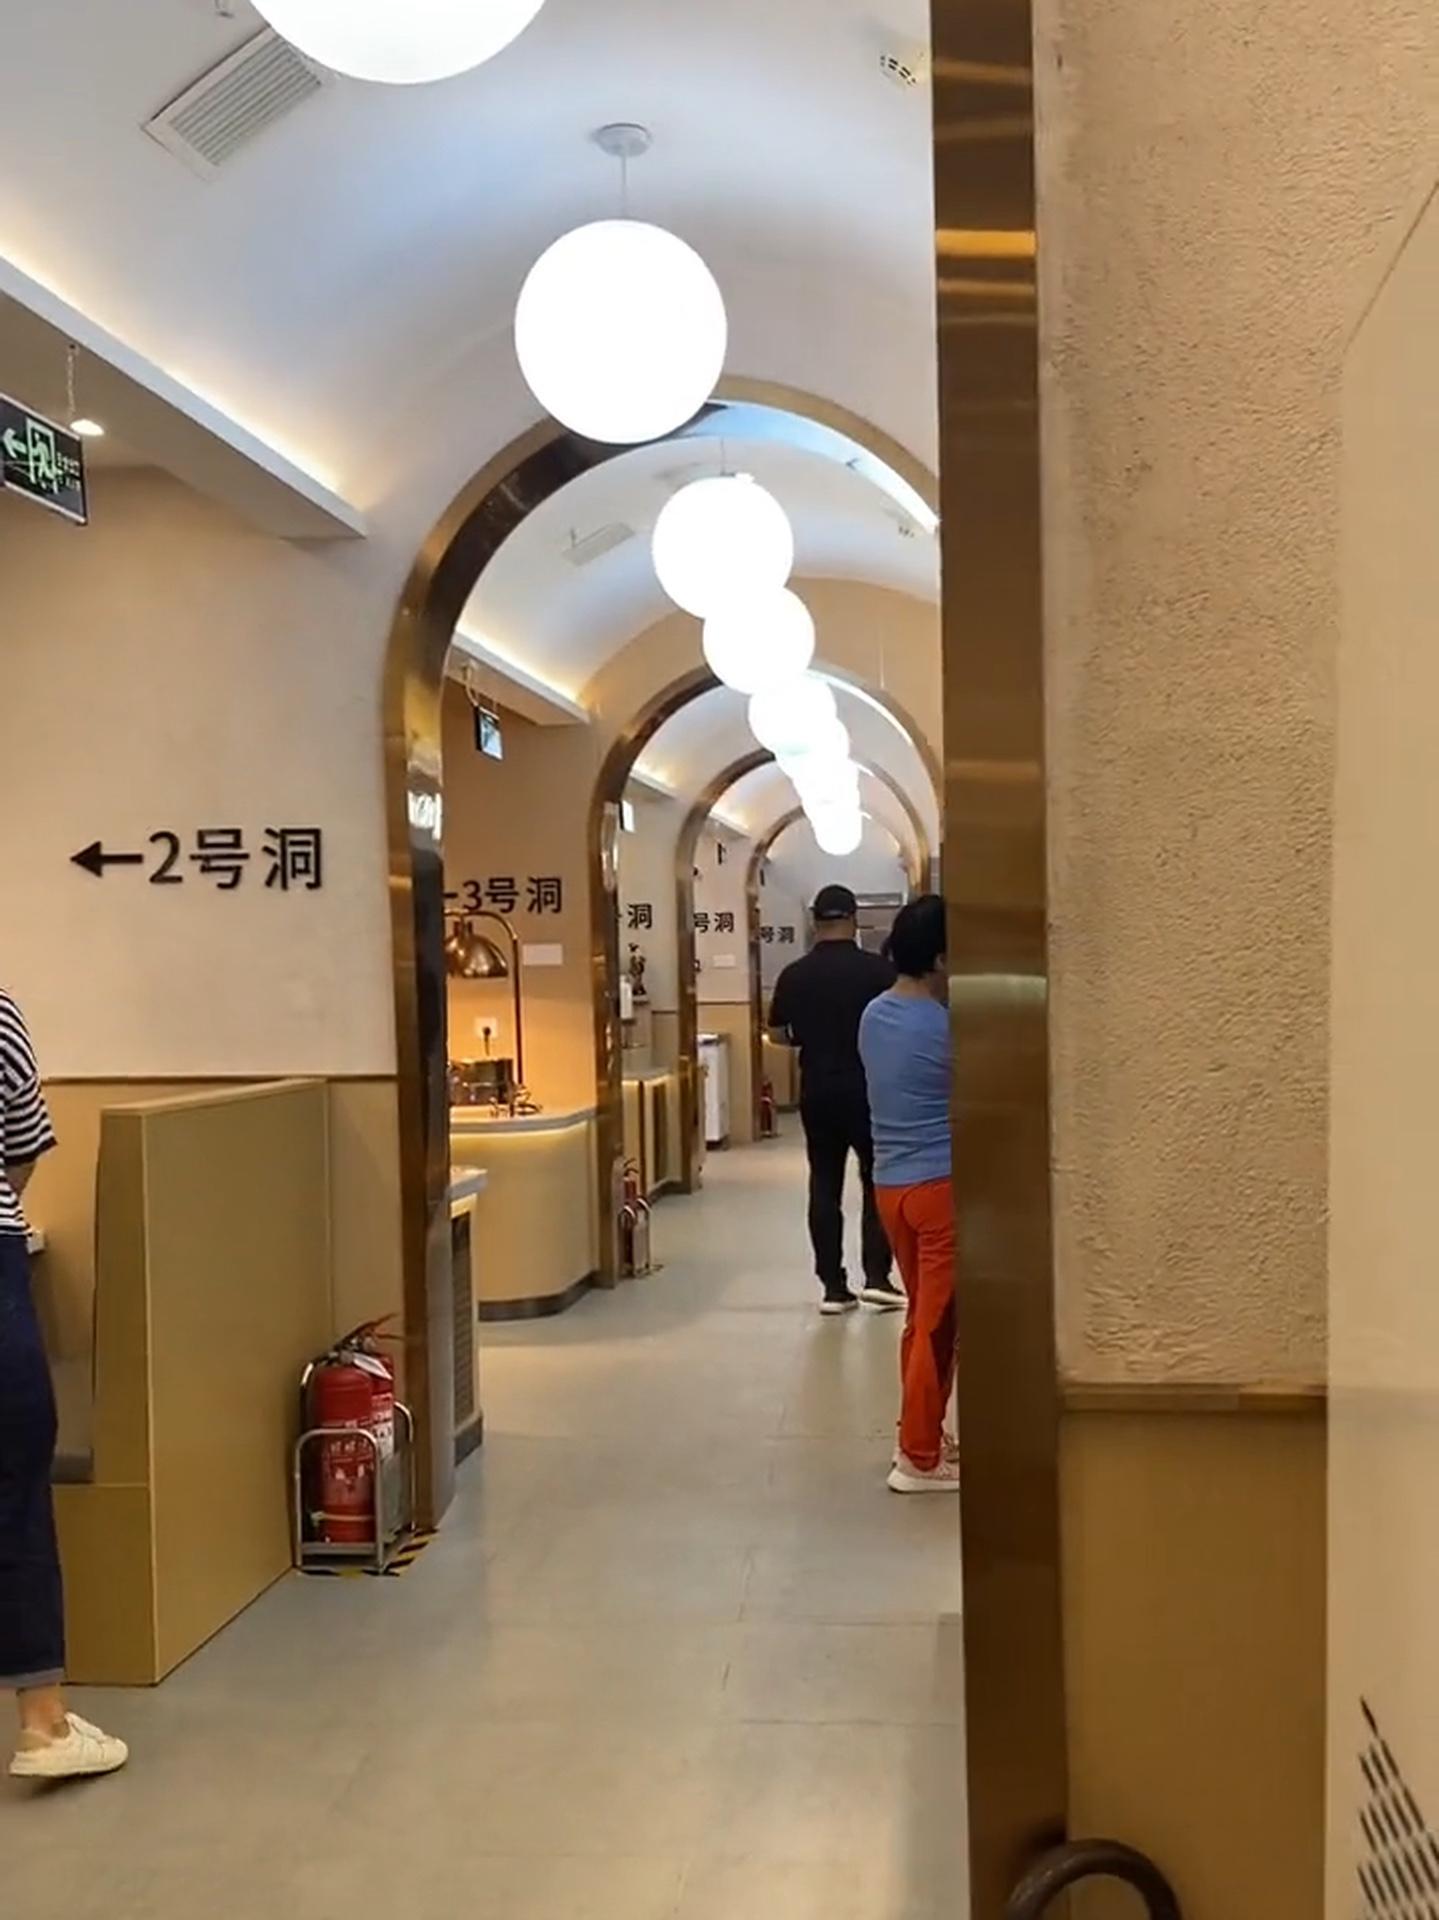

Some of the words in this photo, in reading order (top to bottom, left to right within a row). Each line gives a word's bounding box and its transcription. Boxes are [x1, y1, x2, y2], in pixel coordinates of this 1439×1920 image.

[149, 827, 322, 891] 2号洞
[463, 876, 562, 914] 3号洞
[617, 903, 653, 930] 洞
[693, 912, 735, 934] 号洞
